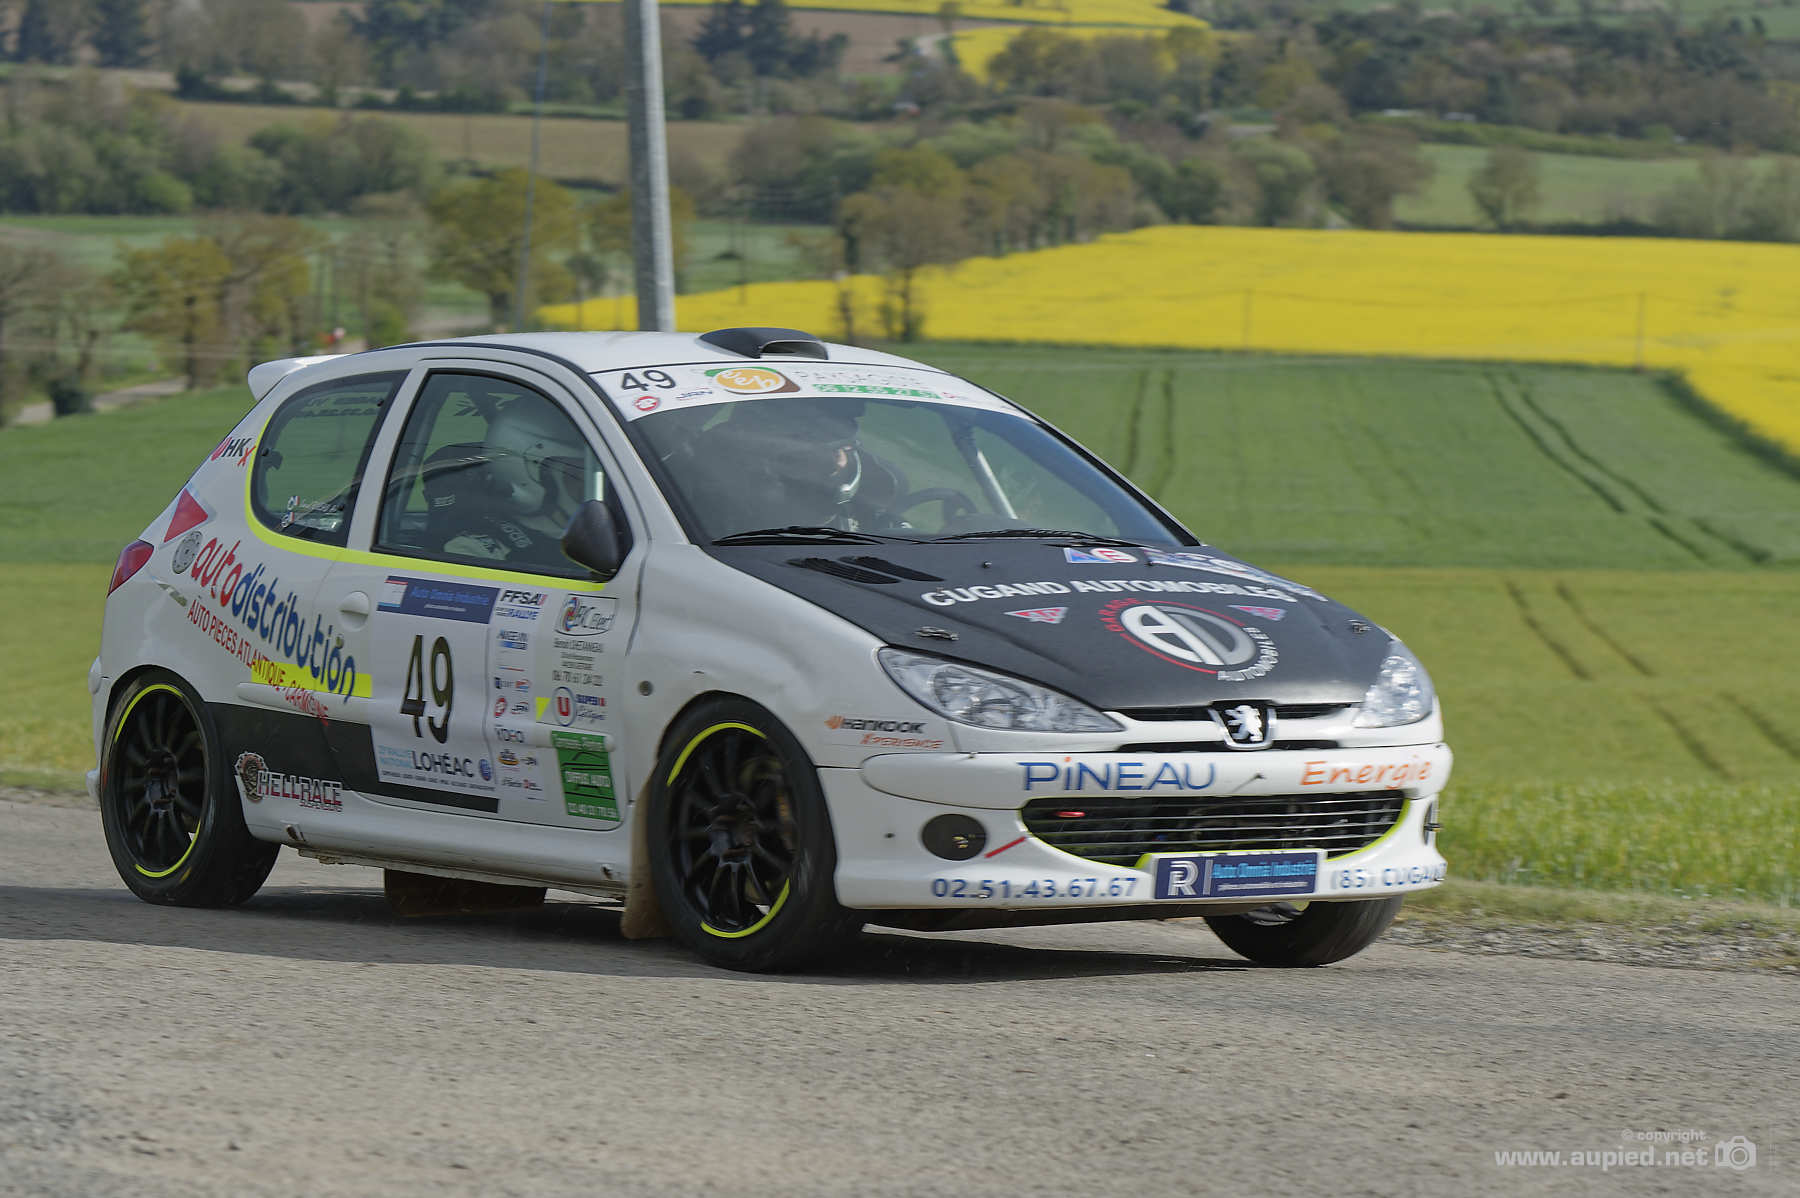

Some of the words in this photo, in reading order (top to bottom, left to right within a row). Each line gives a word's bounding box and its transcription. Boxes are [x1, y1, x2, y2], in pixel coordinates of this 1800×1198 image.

[619, 370, 676, 393] 49
[500, 589, 541, 606] FFSA
[921, 582, 1071, 606] CUGAND
[187, 598, 211, 635] AUTO
[208, 612, 238, 655] PIECES
[237, 640, 286, 691] ATLANTIQUE
[400, 634, 454, 744] 49
[557, 696, 571, 717] U
[411, 750, 475, 778] LOHÉAC
[1300, 755, 1432, 791] Energie
[257, 769, 343, 806] HELLRACE
[931, 877, 1138, 899] 02.51.43.67.67
